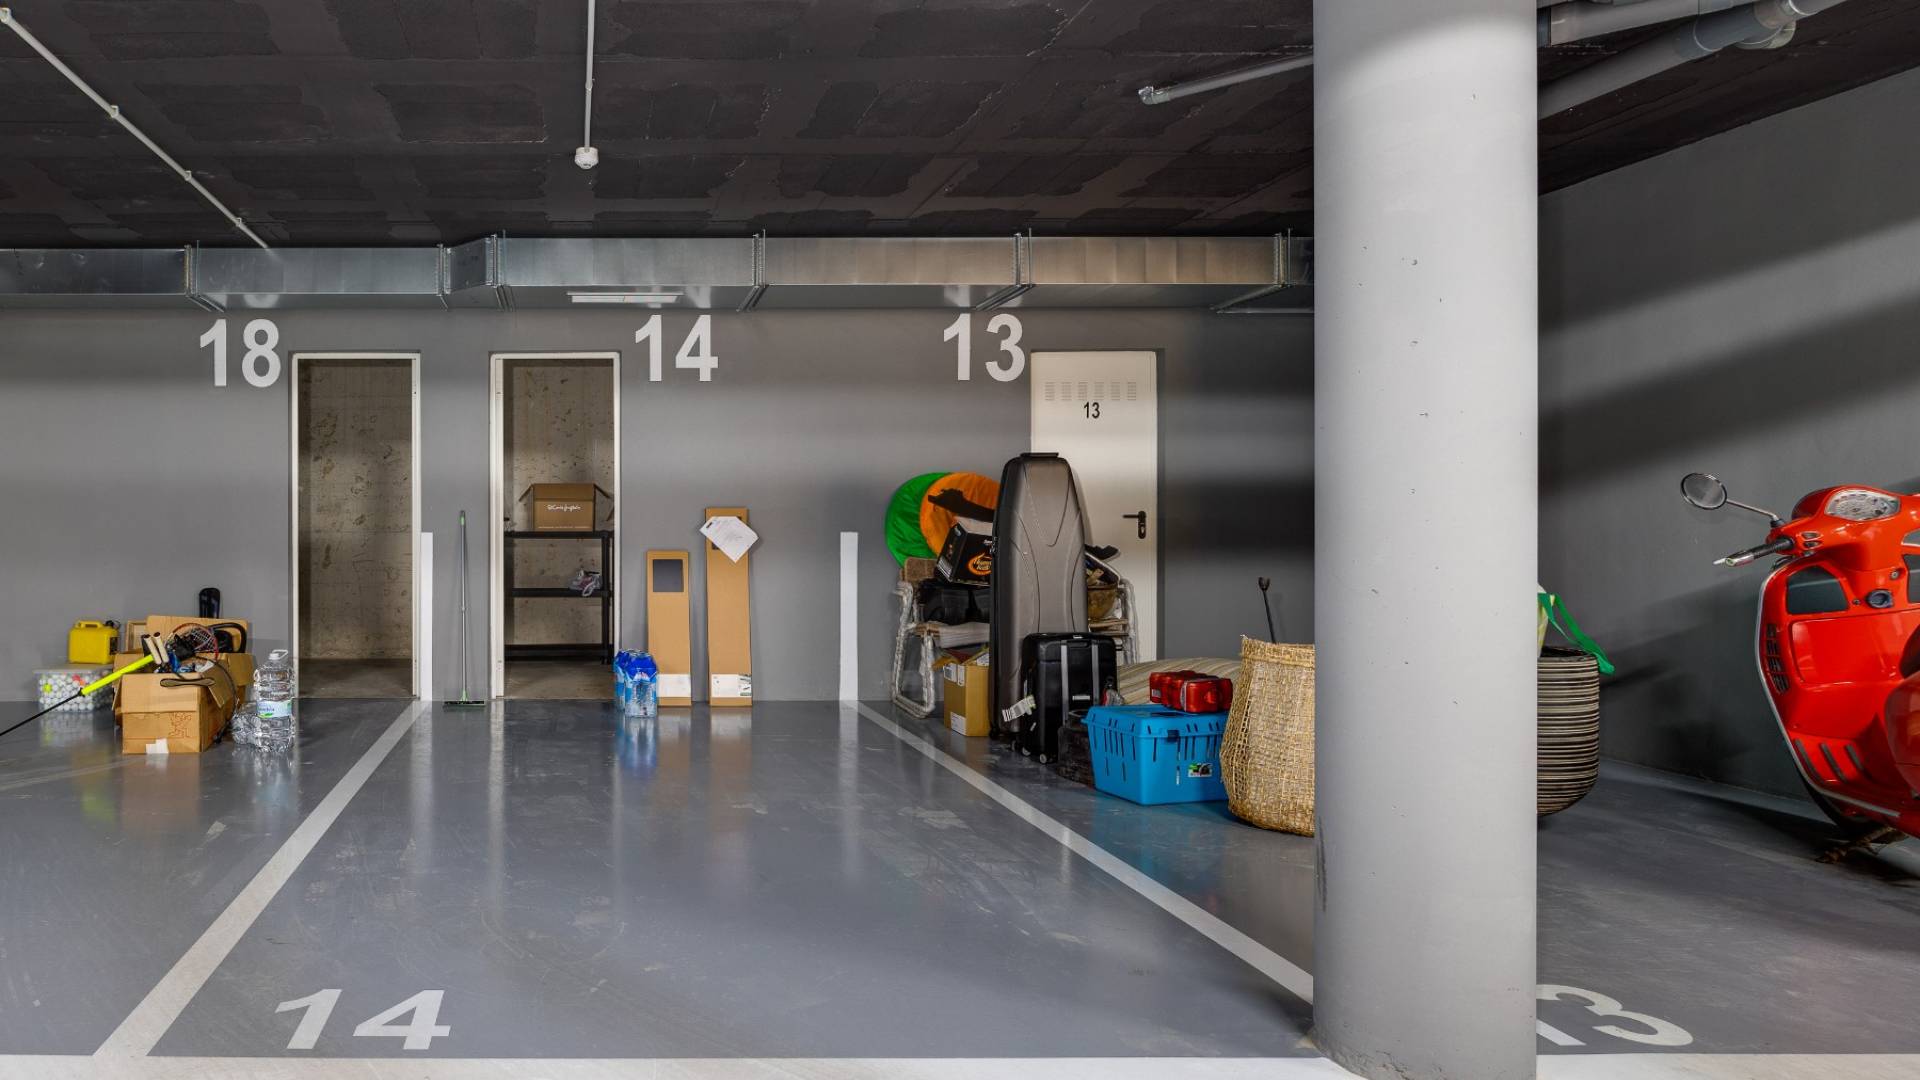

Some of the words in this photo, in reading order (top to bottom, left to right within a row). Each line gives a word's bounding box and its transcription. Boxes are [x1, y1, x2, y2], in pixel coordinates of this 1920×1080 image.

[200, 319, 281, 387] 18
[636, 315, 718, 381] 14
[944, 313, 1025, 382] 13
[1084, 401, 1100, 419] 13
[275, 989, 450, 1049] 14
